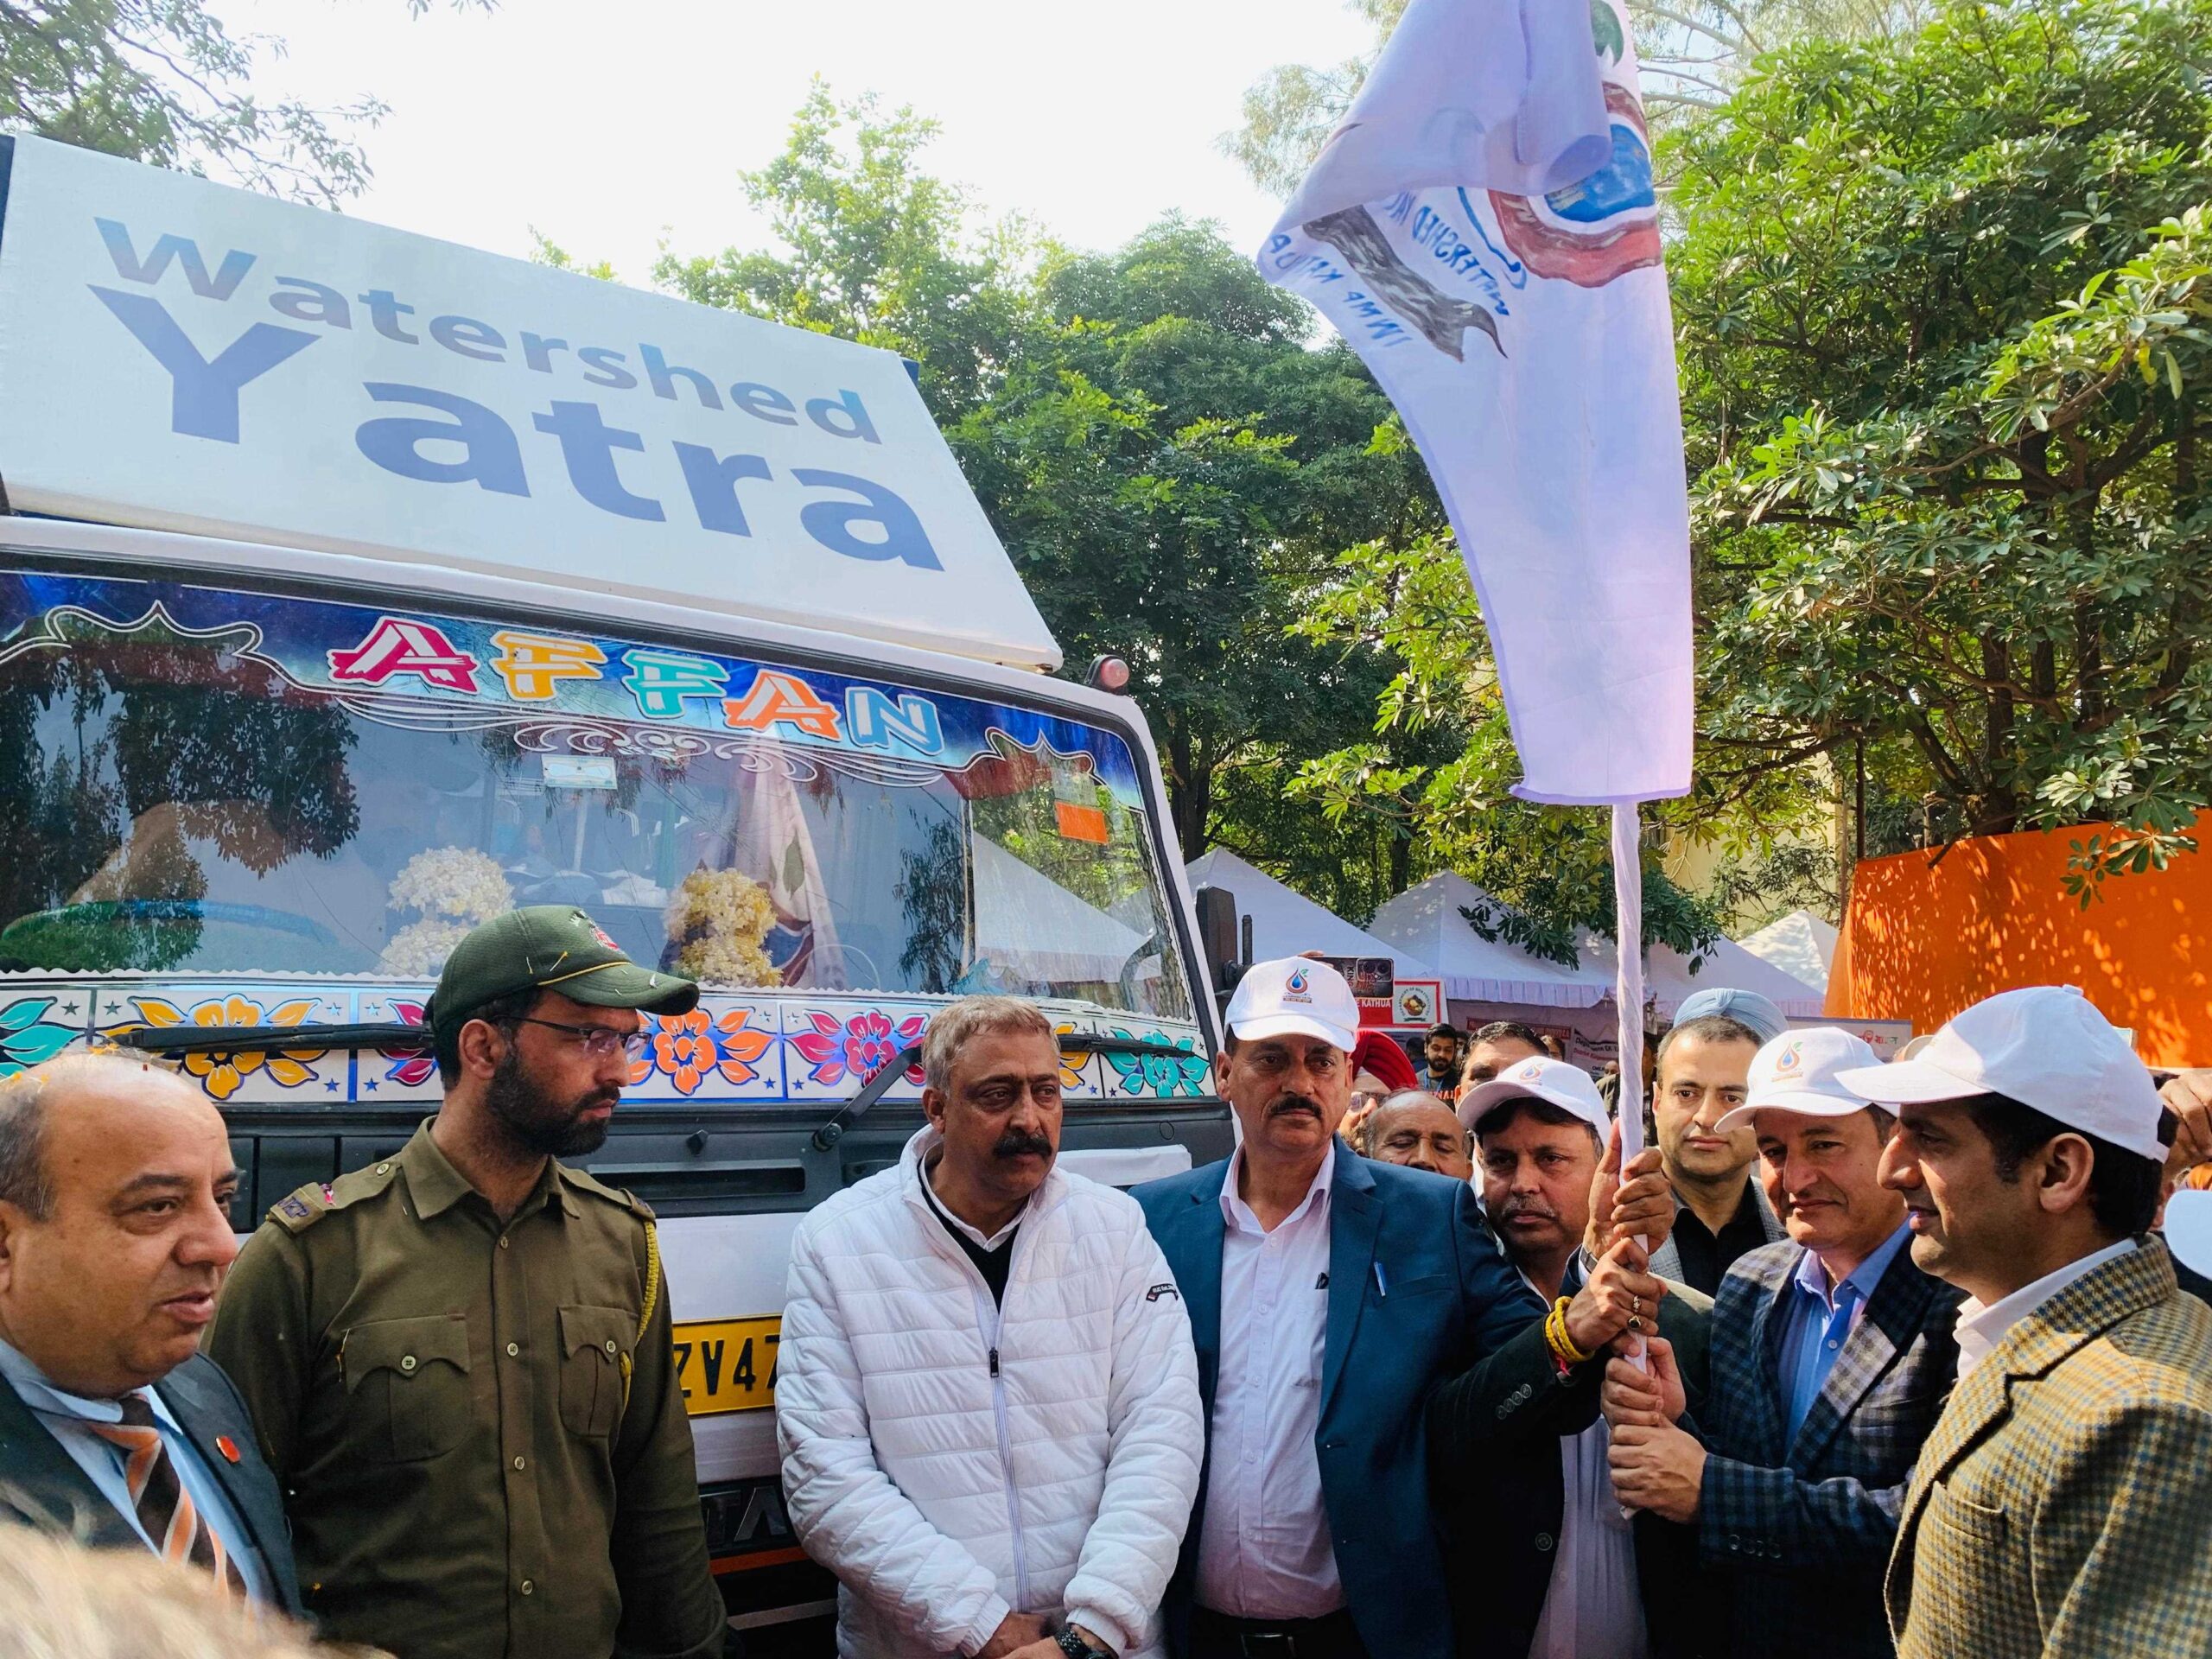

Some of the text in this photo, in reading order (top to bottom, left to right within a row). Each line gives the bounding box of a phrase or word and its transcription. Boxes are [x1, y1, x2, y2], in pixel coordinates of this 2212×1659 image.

[93, 215, 880, 444] Watershed
[87, 284, 945, 571] Yatra
[327, 614, 944, 755] AFFAN
[1361, 999, 1392, 1008] KATHUA
